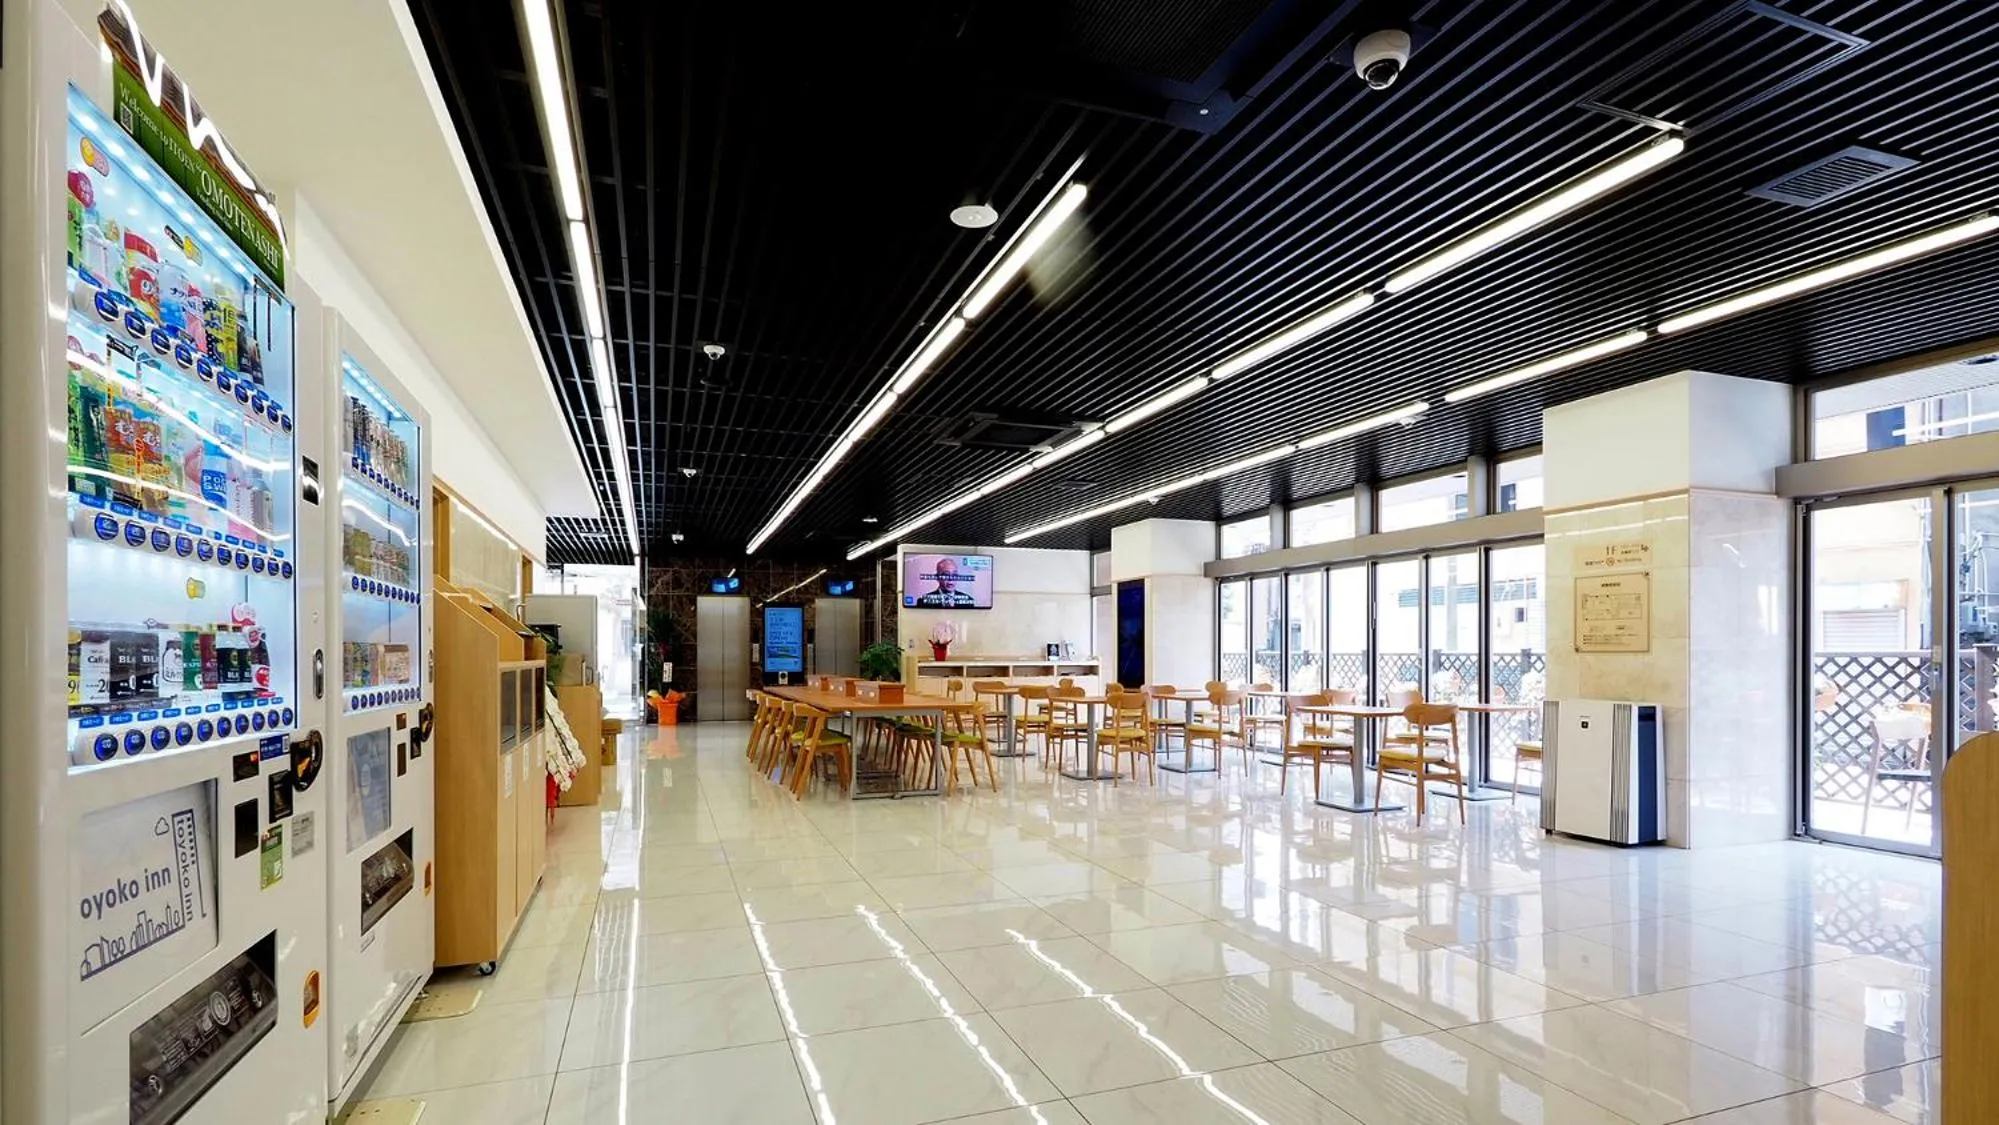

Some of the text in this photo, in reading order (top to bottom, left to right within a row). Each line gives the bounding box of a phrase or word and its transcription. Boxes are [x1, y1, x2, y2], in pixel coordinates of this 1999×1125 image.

[120, 83, 160, 136] Welcome
[80, 867, 172, 920] oyoko inn
[176, 817, 195, 922] toyoko inn
